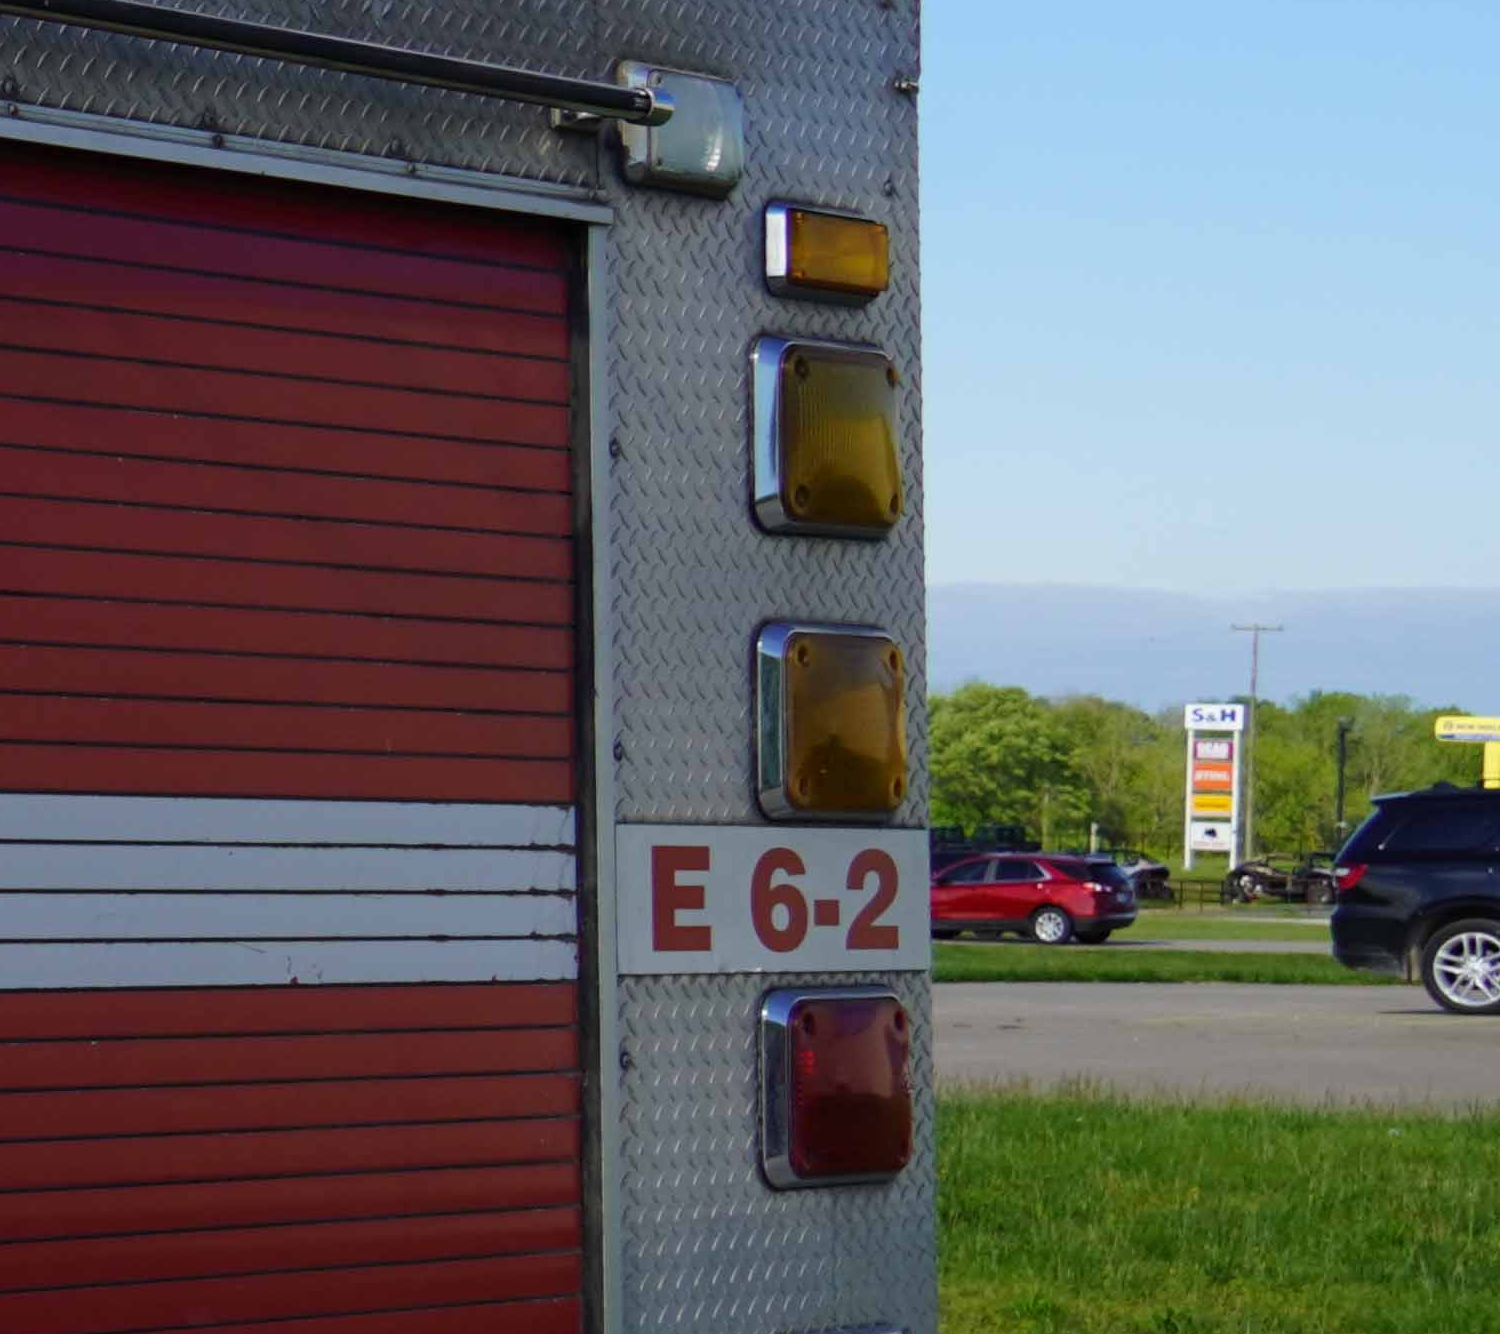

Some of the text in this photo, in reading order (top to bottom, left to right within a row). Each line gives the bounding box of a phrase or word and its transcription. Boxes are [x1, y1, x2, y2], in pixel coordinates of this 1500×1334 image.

[1192, 708, 1237, 723] S & H
[652, 845, 899, 953] E 6-2
